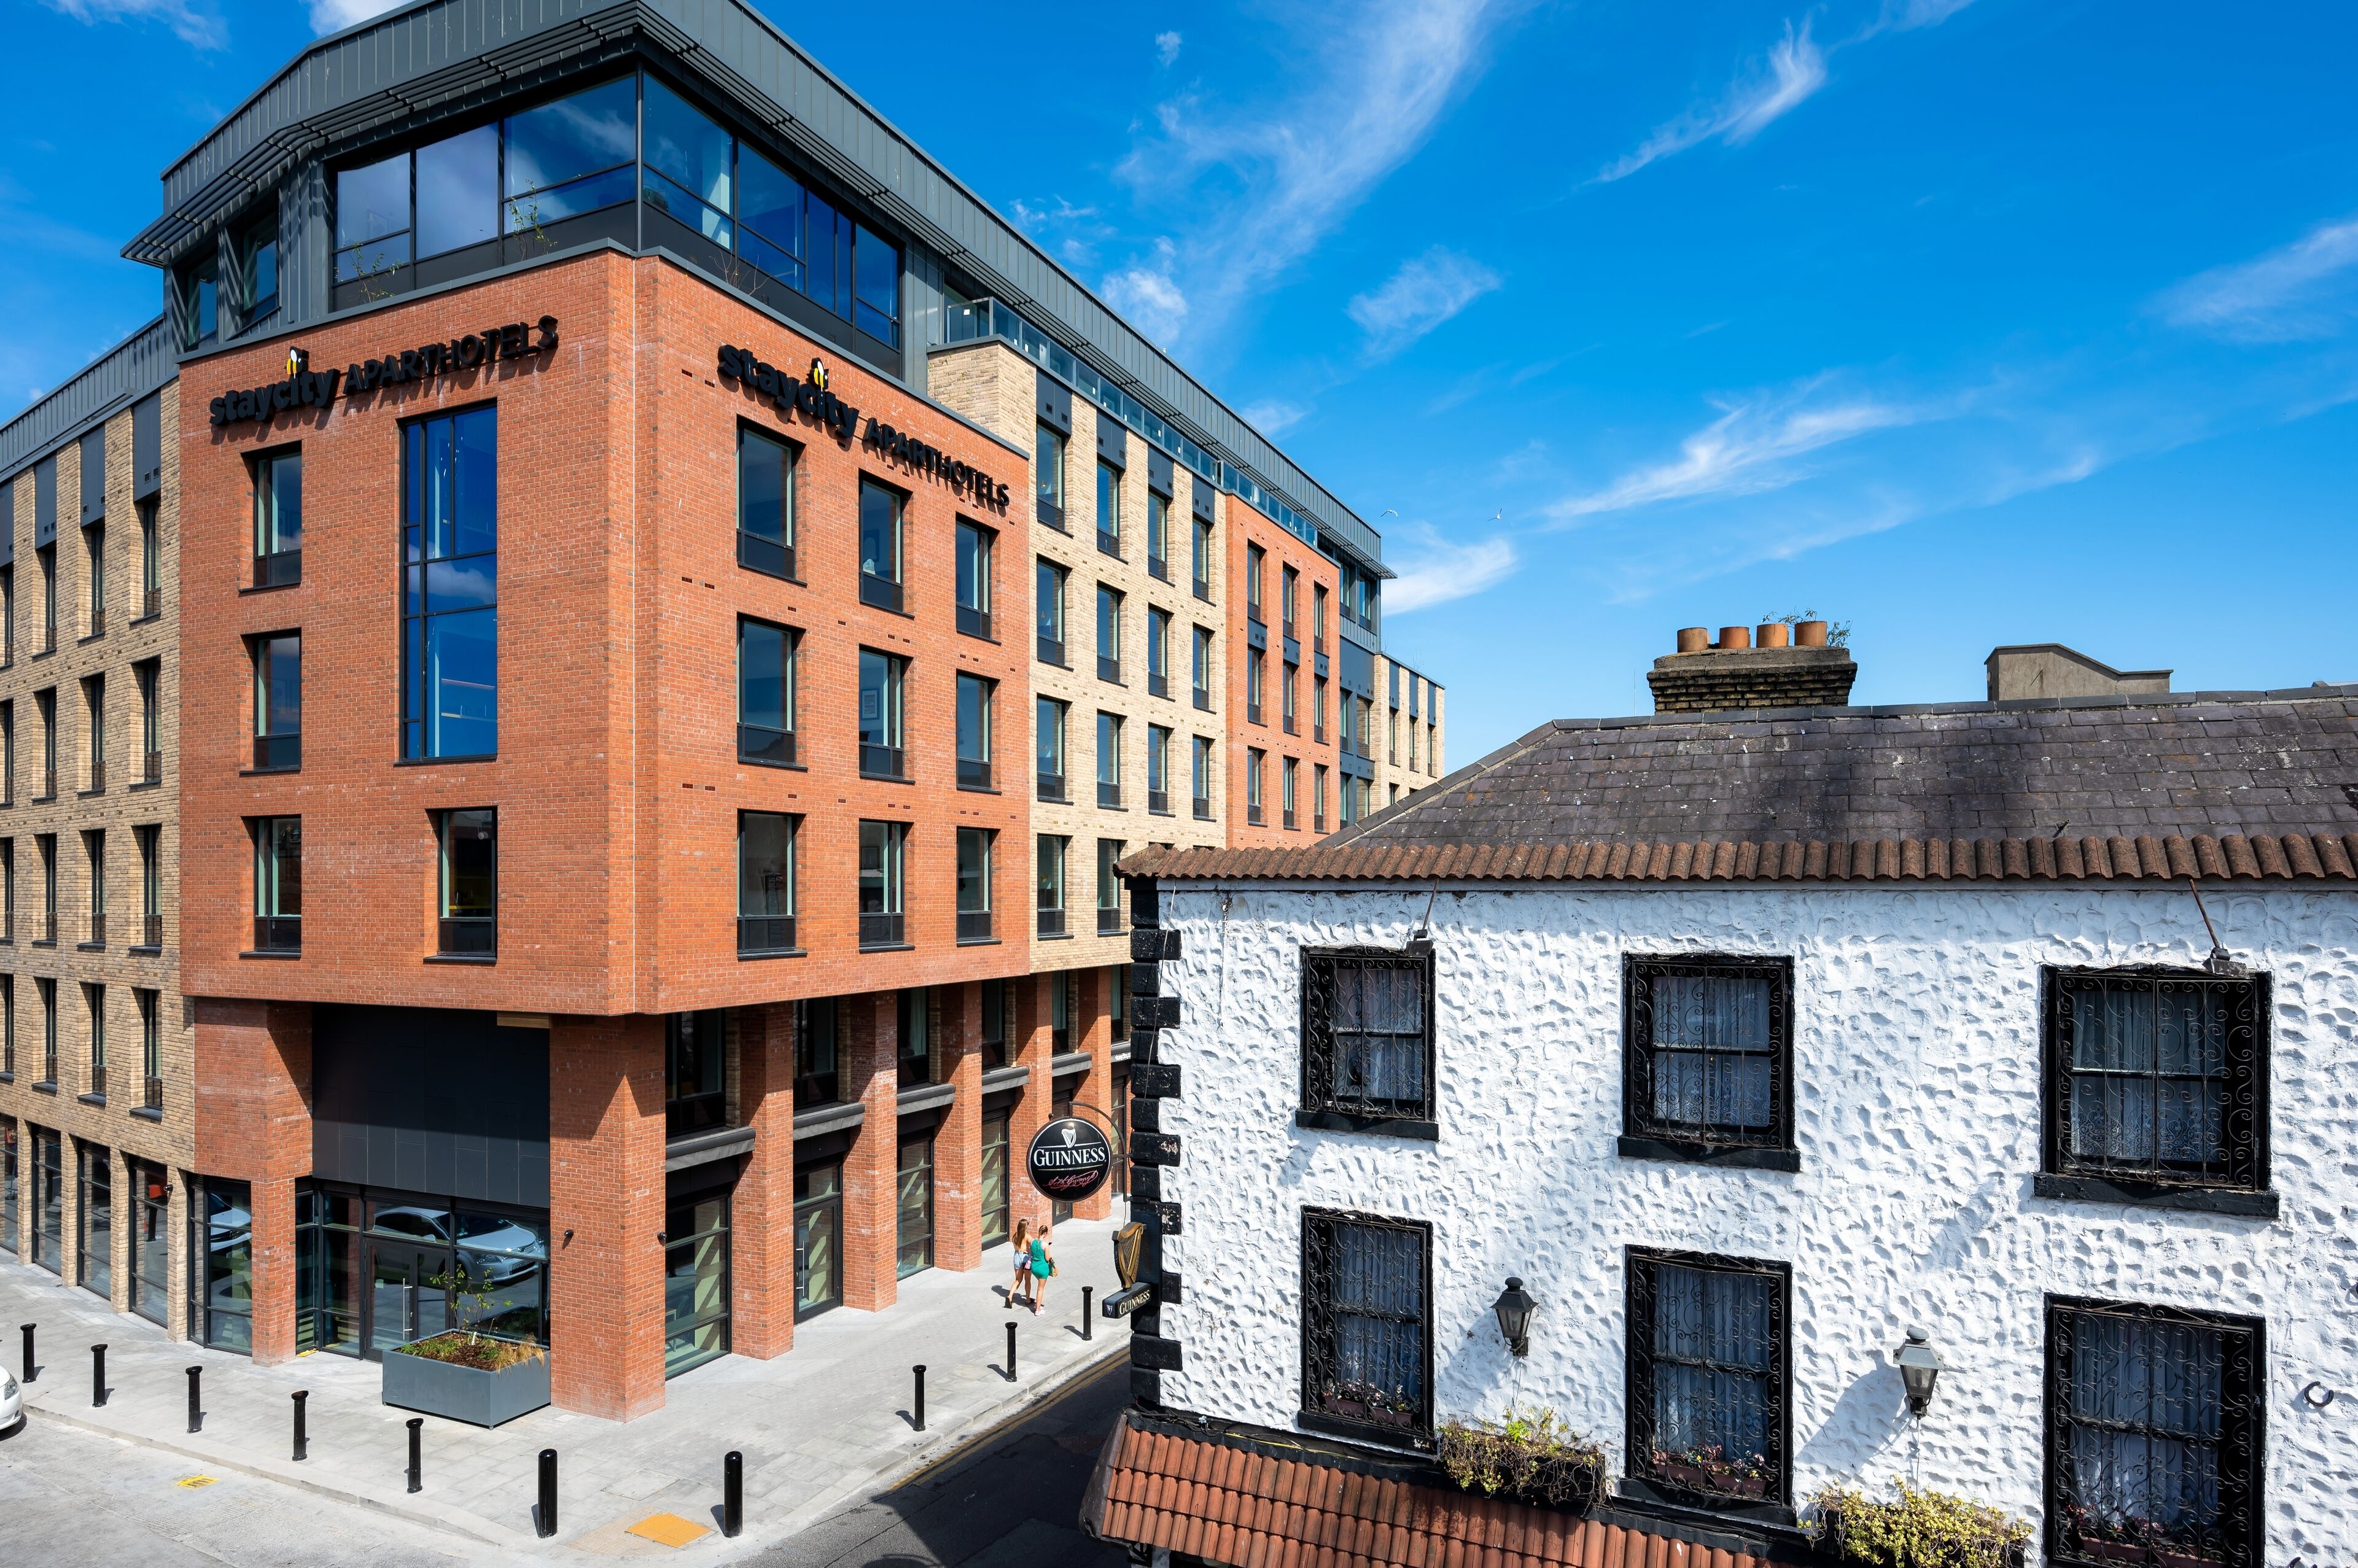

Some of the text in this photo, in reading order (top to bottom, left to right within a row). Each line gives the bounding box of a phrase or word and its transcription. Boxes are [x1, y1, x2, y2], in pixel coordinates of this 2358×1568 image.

[209, 315, 559, 425] staycity APARTHOTELS
[717, 344, 1010, 507] staycity APARTHOTELS
[1033, 1147, 1105, 1166] GUINNESS
[1119, 1290, 1150, 1315] GUINNESS
